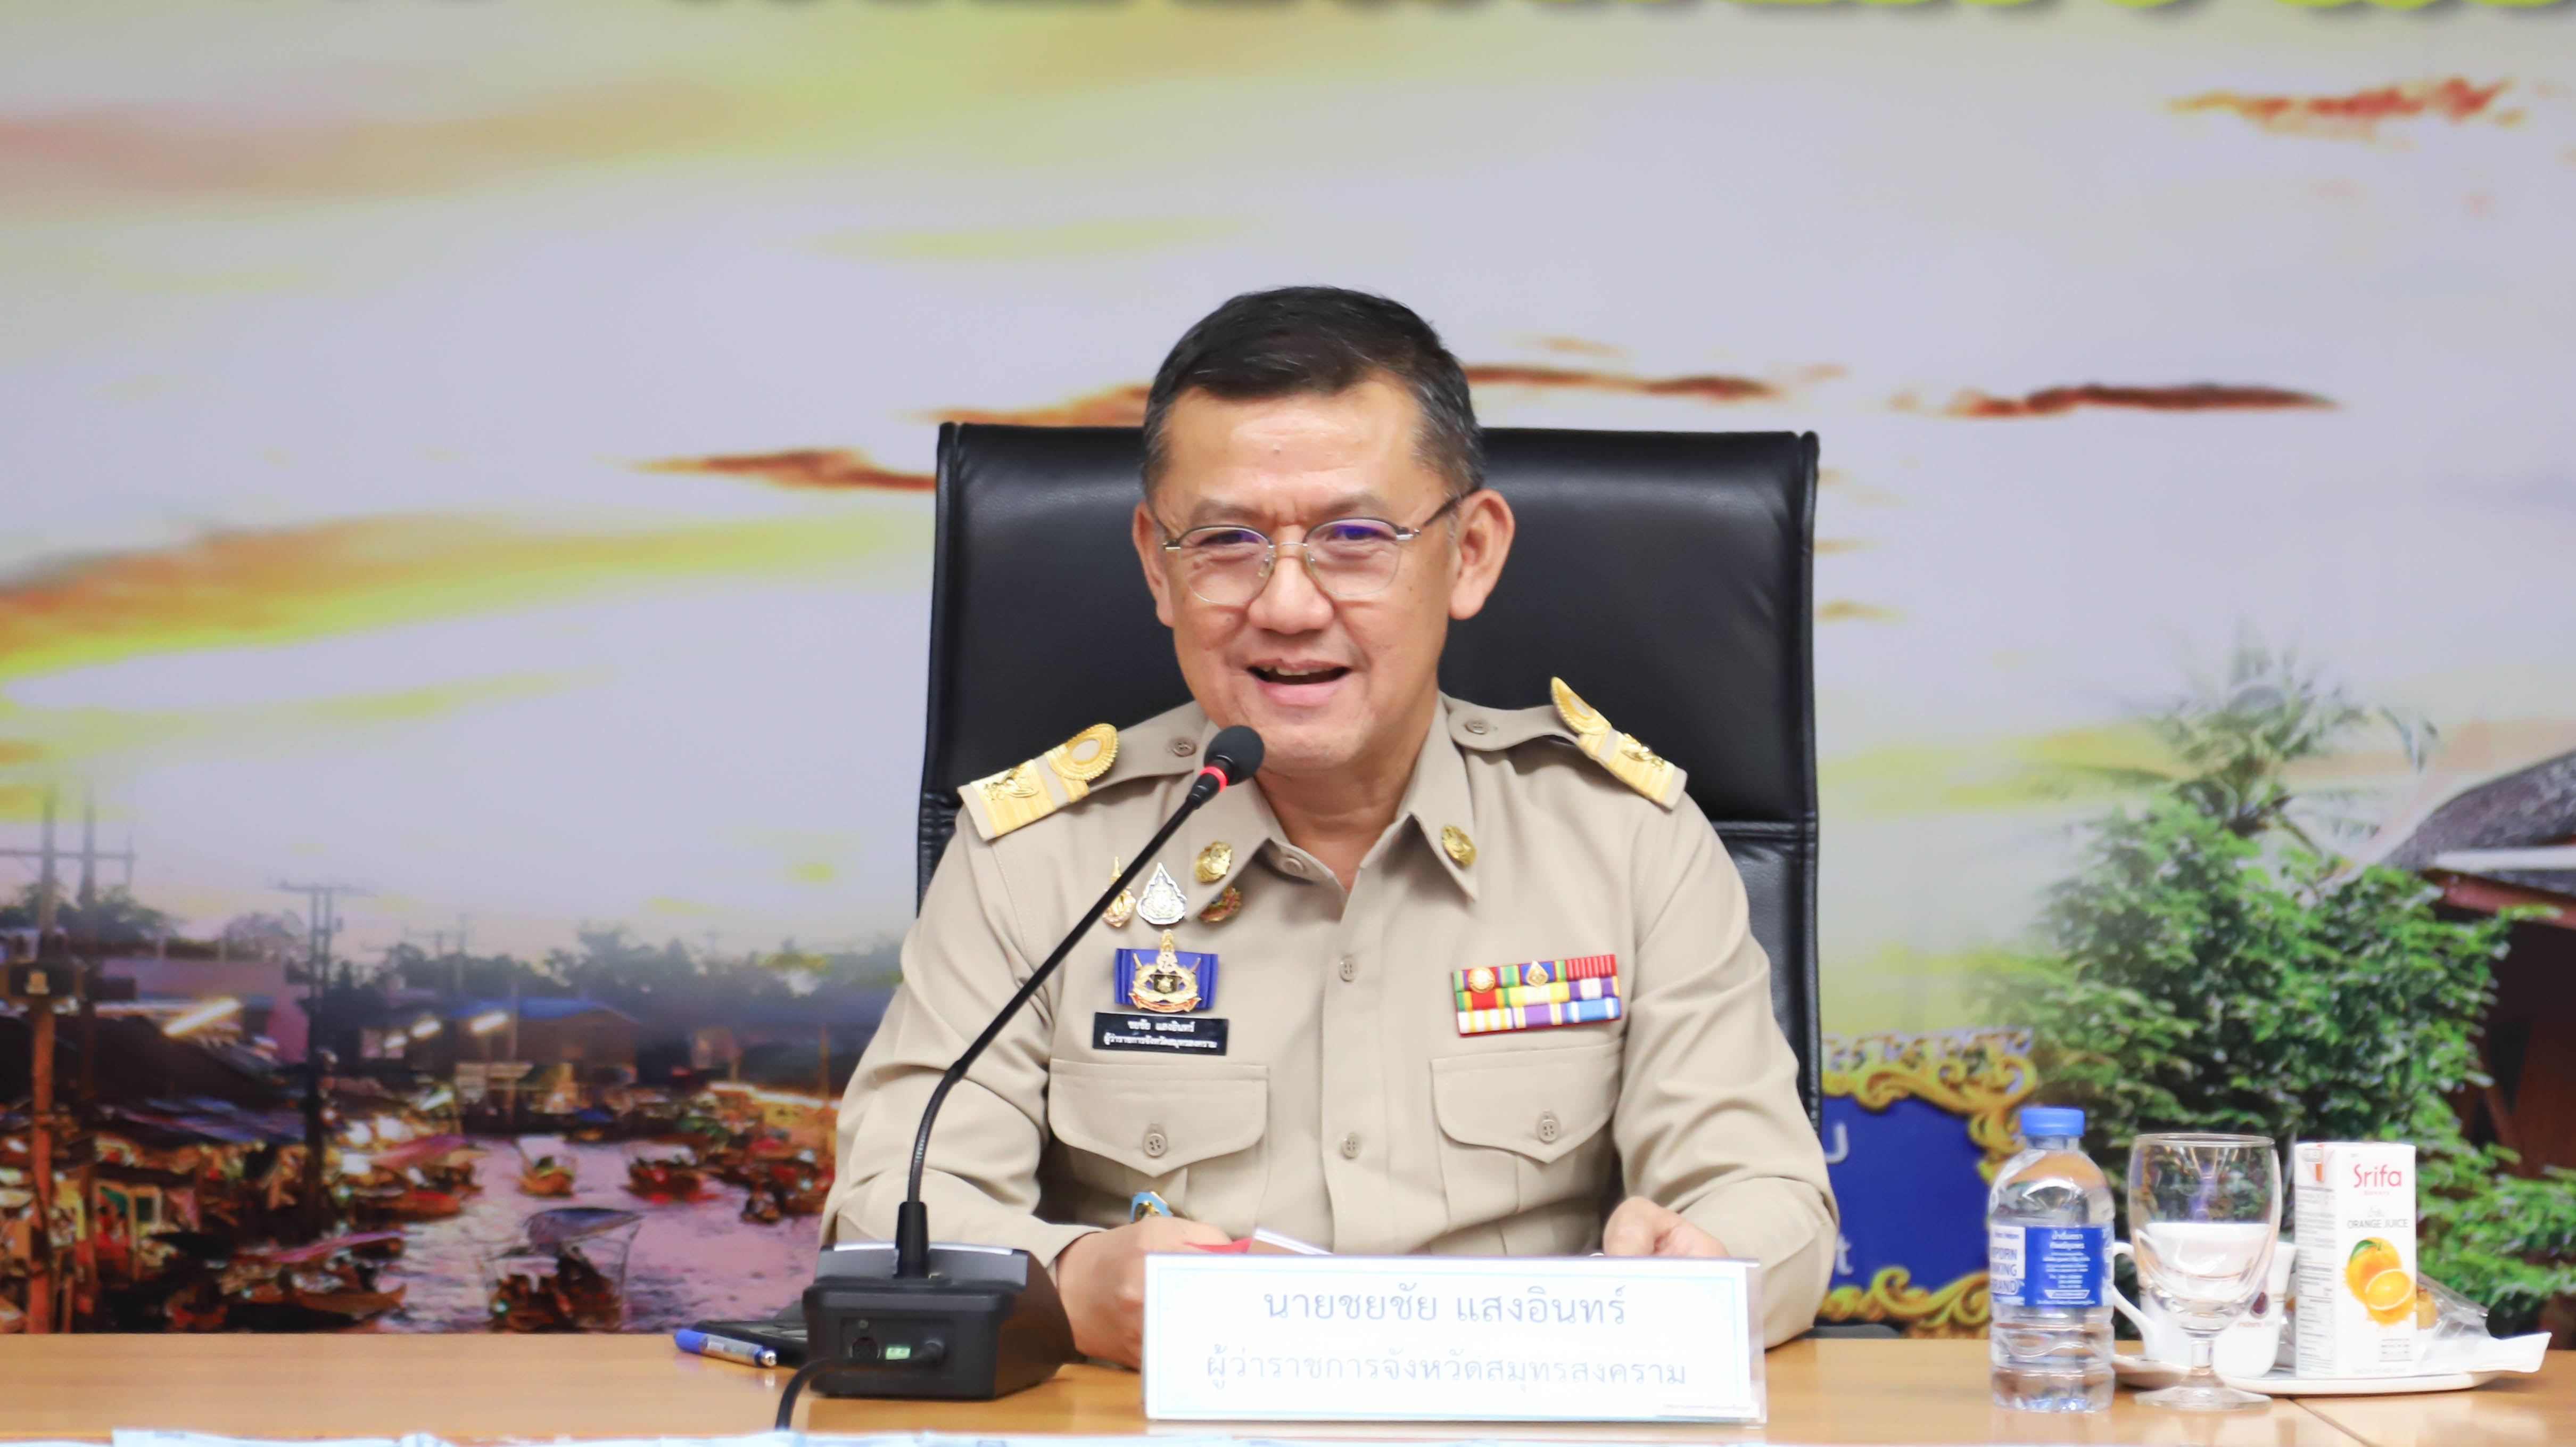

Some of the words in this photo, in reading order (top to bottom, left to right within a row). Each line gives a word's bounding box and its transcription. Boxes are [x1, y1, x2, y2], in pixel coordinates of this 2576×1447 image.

[2352, 1163, 2402, 1188] Srifa
[2347, 1219, 2382, 1229] ORANGE
[2384, 1218, 2408, 1228] JUICE
[1264, 1282, 1437, 1321] นายชยชัย
[1457, 1284, 1626, 1325] แสงอินทร์
[1207, 1343, 1685, 1393] ผู้ว่าราชการจังหวัดสมุทรสงคราม
